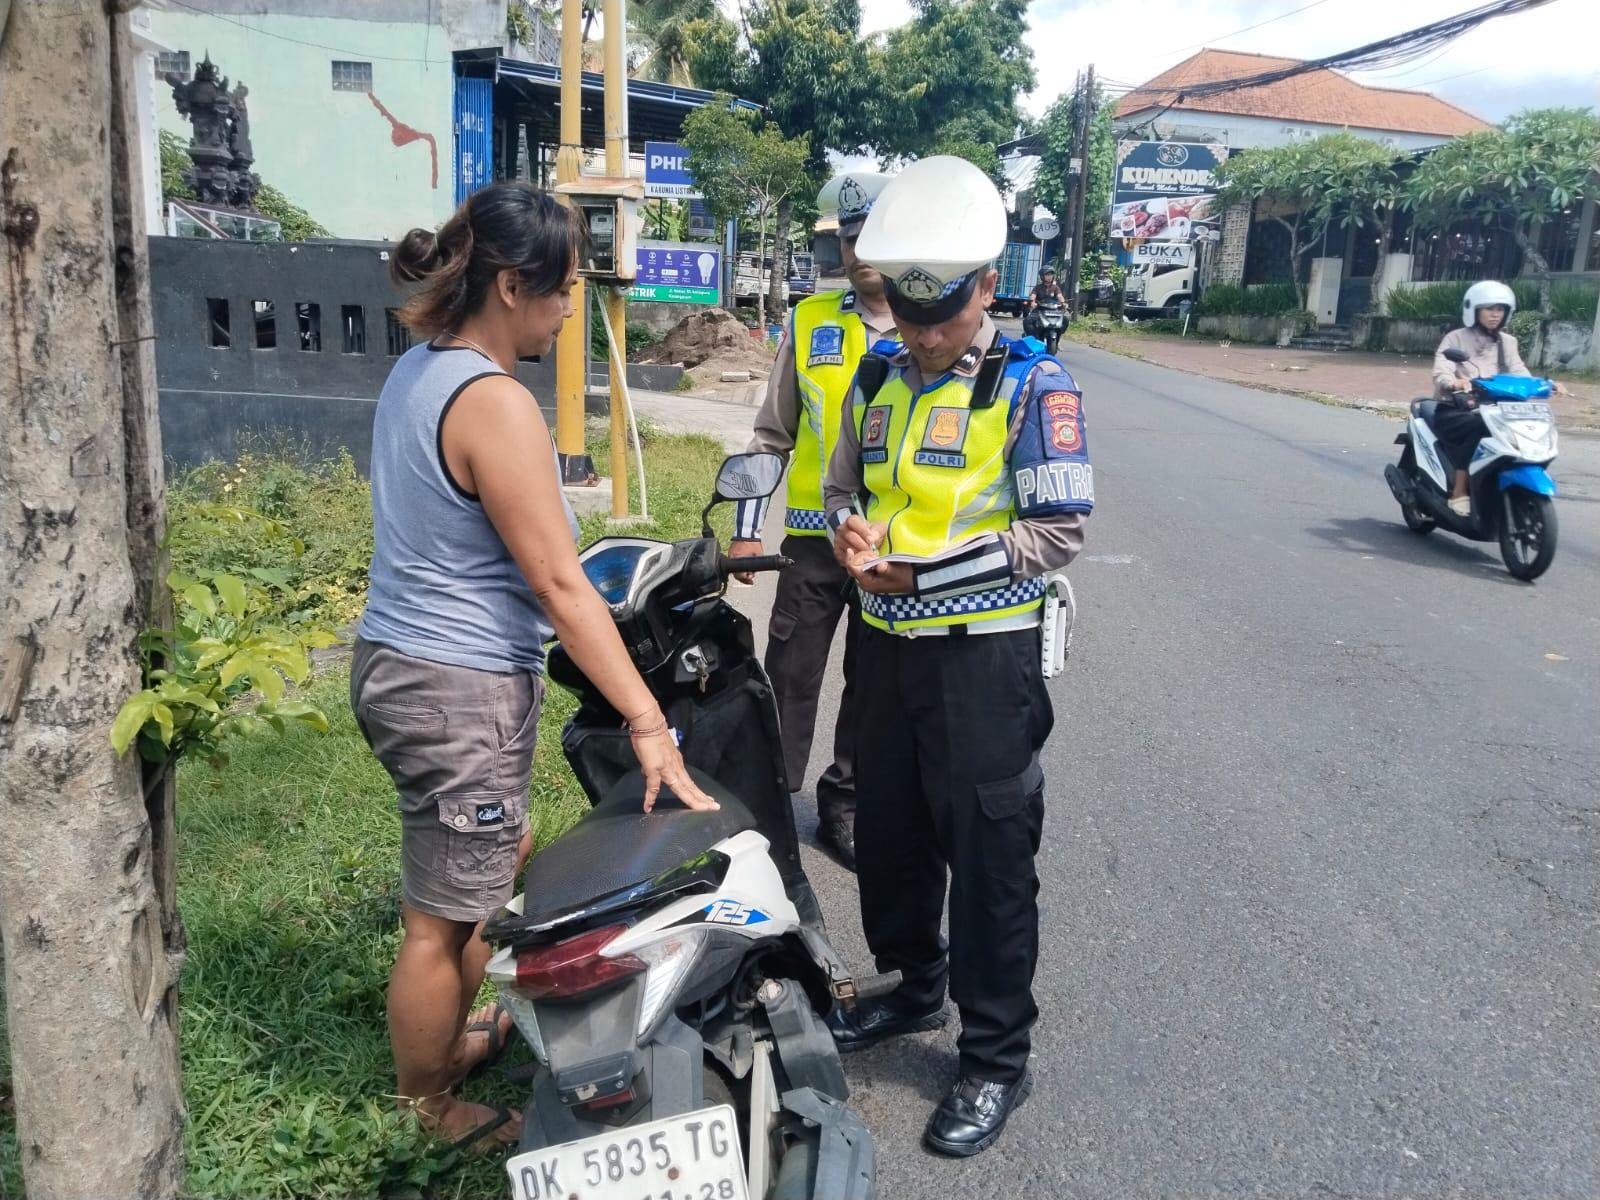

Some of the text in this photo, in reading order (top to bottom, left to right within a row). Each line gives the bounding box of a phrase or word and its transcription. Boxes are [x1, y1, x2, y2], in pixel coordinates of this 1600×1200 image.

[1138, 245, 1182, 257] BUKA
[918, 453, 961, 466] POLRI
[1015, 462, 1095, 508] PATRO
[704, 901, 751, 925] 125
[520, 1119, 730, 1200] DK 5835 TG
